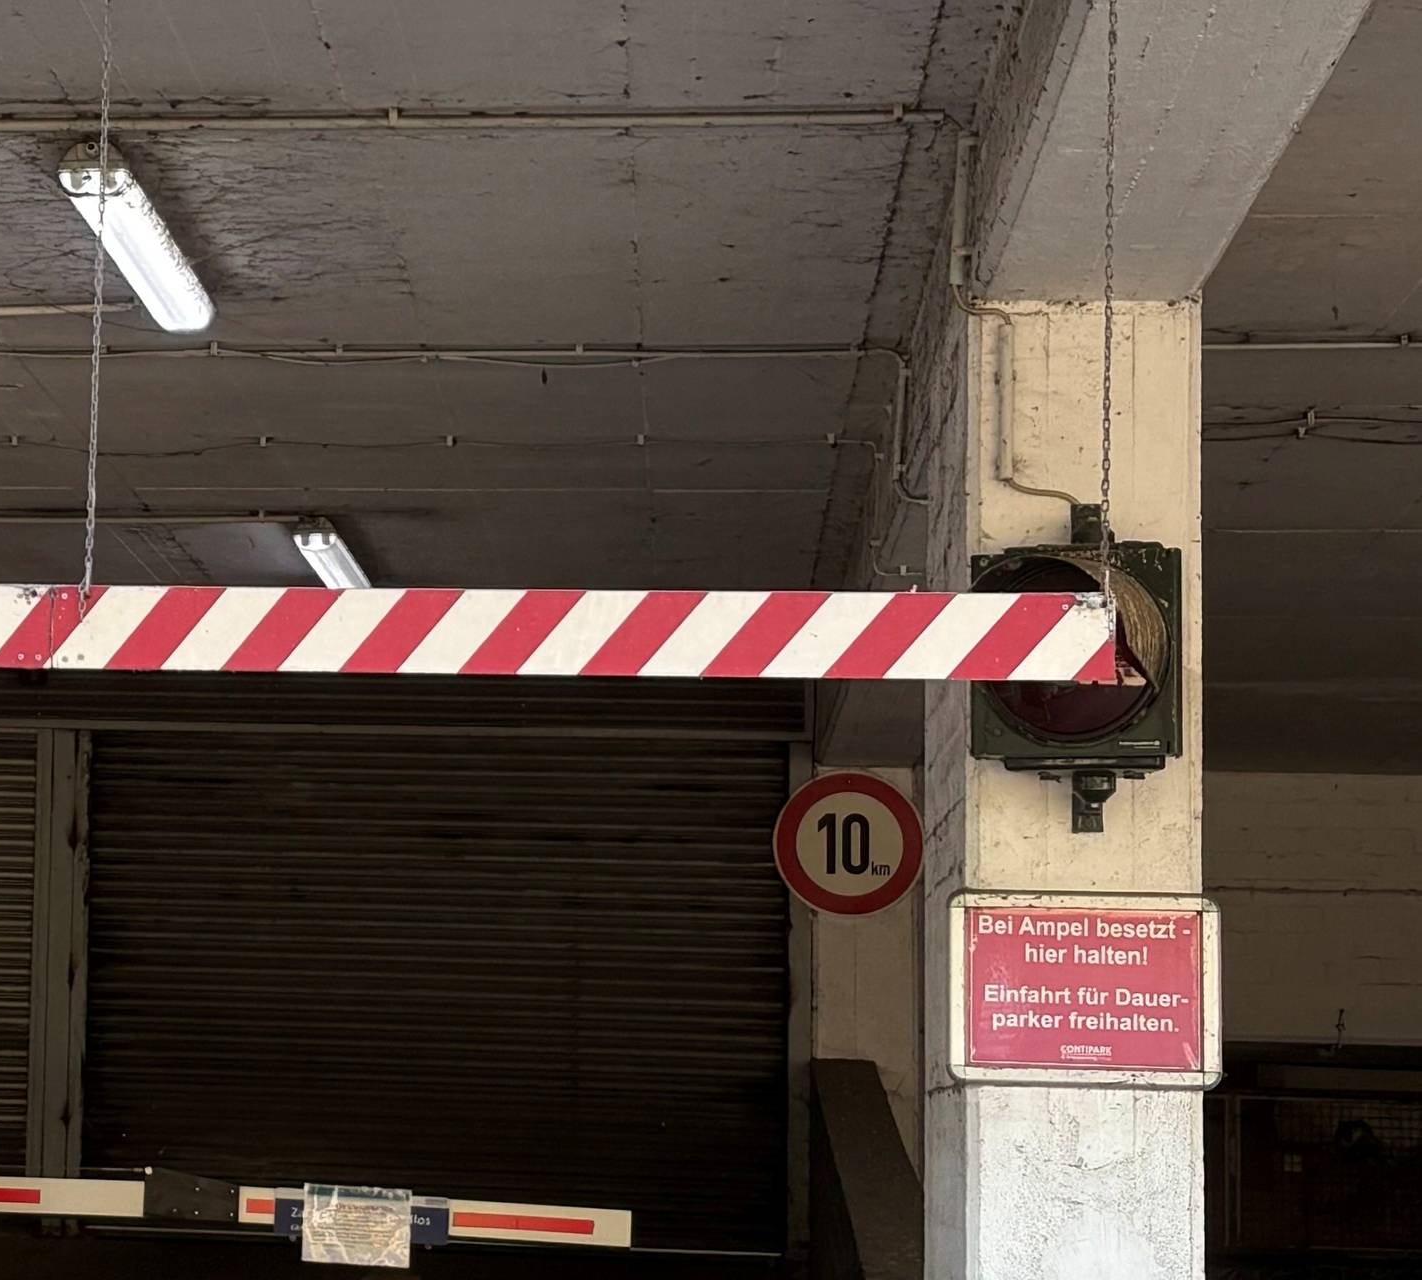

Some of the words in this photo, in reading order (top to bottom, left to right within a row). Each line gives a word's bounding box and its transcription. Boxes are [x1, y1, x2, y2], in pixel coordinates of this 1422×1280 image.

[818, 813, 869, 875] 10
[872, 861, 890, 876] km
[978, 914, 1014, 935] Bei
[1019, 916, 1089, 941] Ampel
[1096, 918, 1176, 939] besetzt
[1025, 943, 1067, 963] hier
[1073, 944, 1148, 965] halten!
[984, 984, 1071, 1004] Einfahrt
[1077, 987, 1109, 1006] für
[1115, 988, 1189, 1007] Dauer-
[992, 1010, 1063, 1030] parker
[1069, 1012, 1179, 1032] freihalten.
[1059, 1044, 1112, 1056] CONTIPARK
